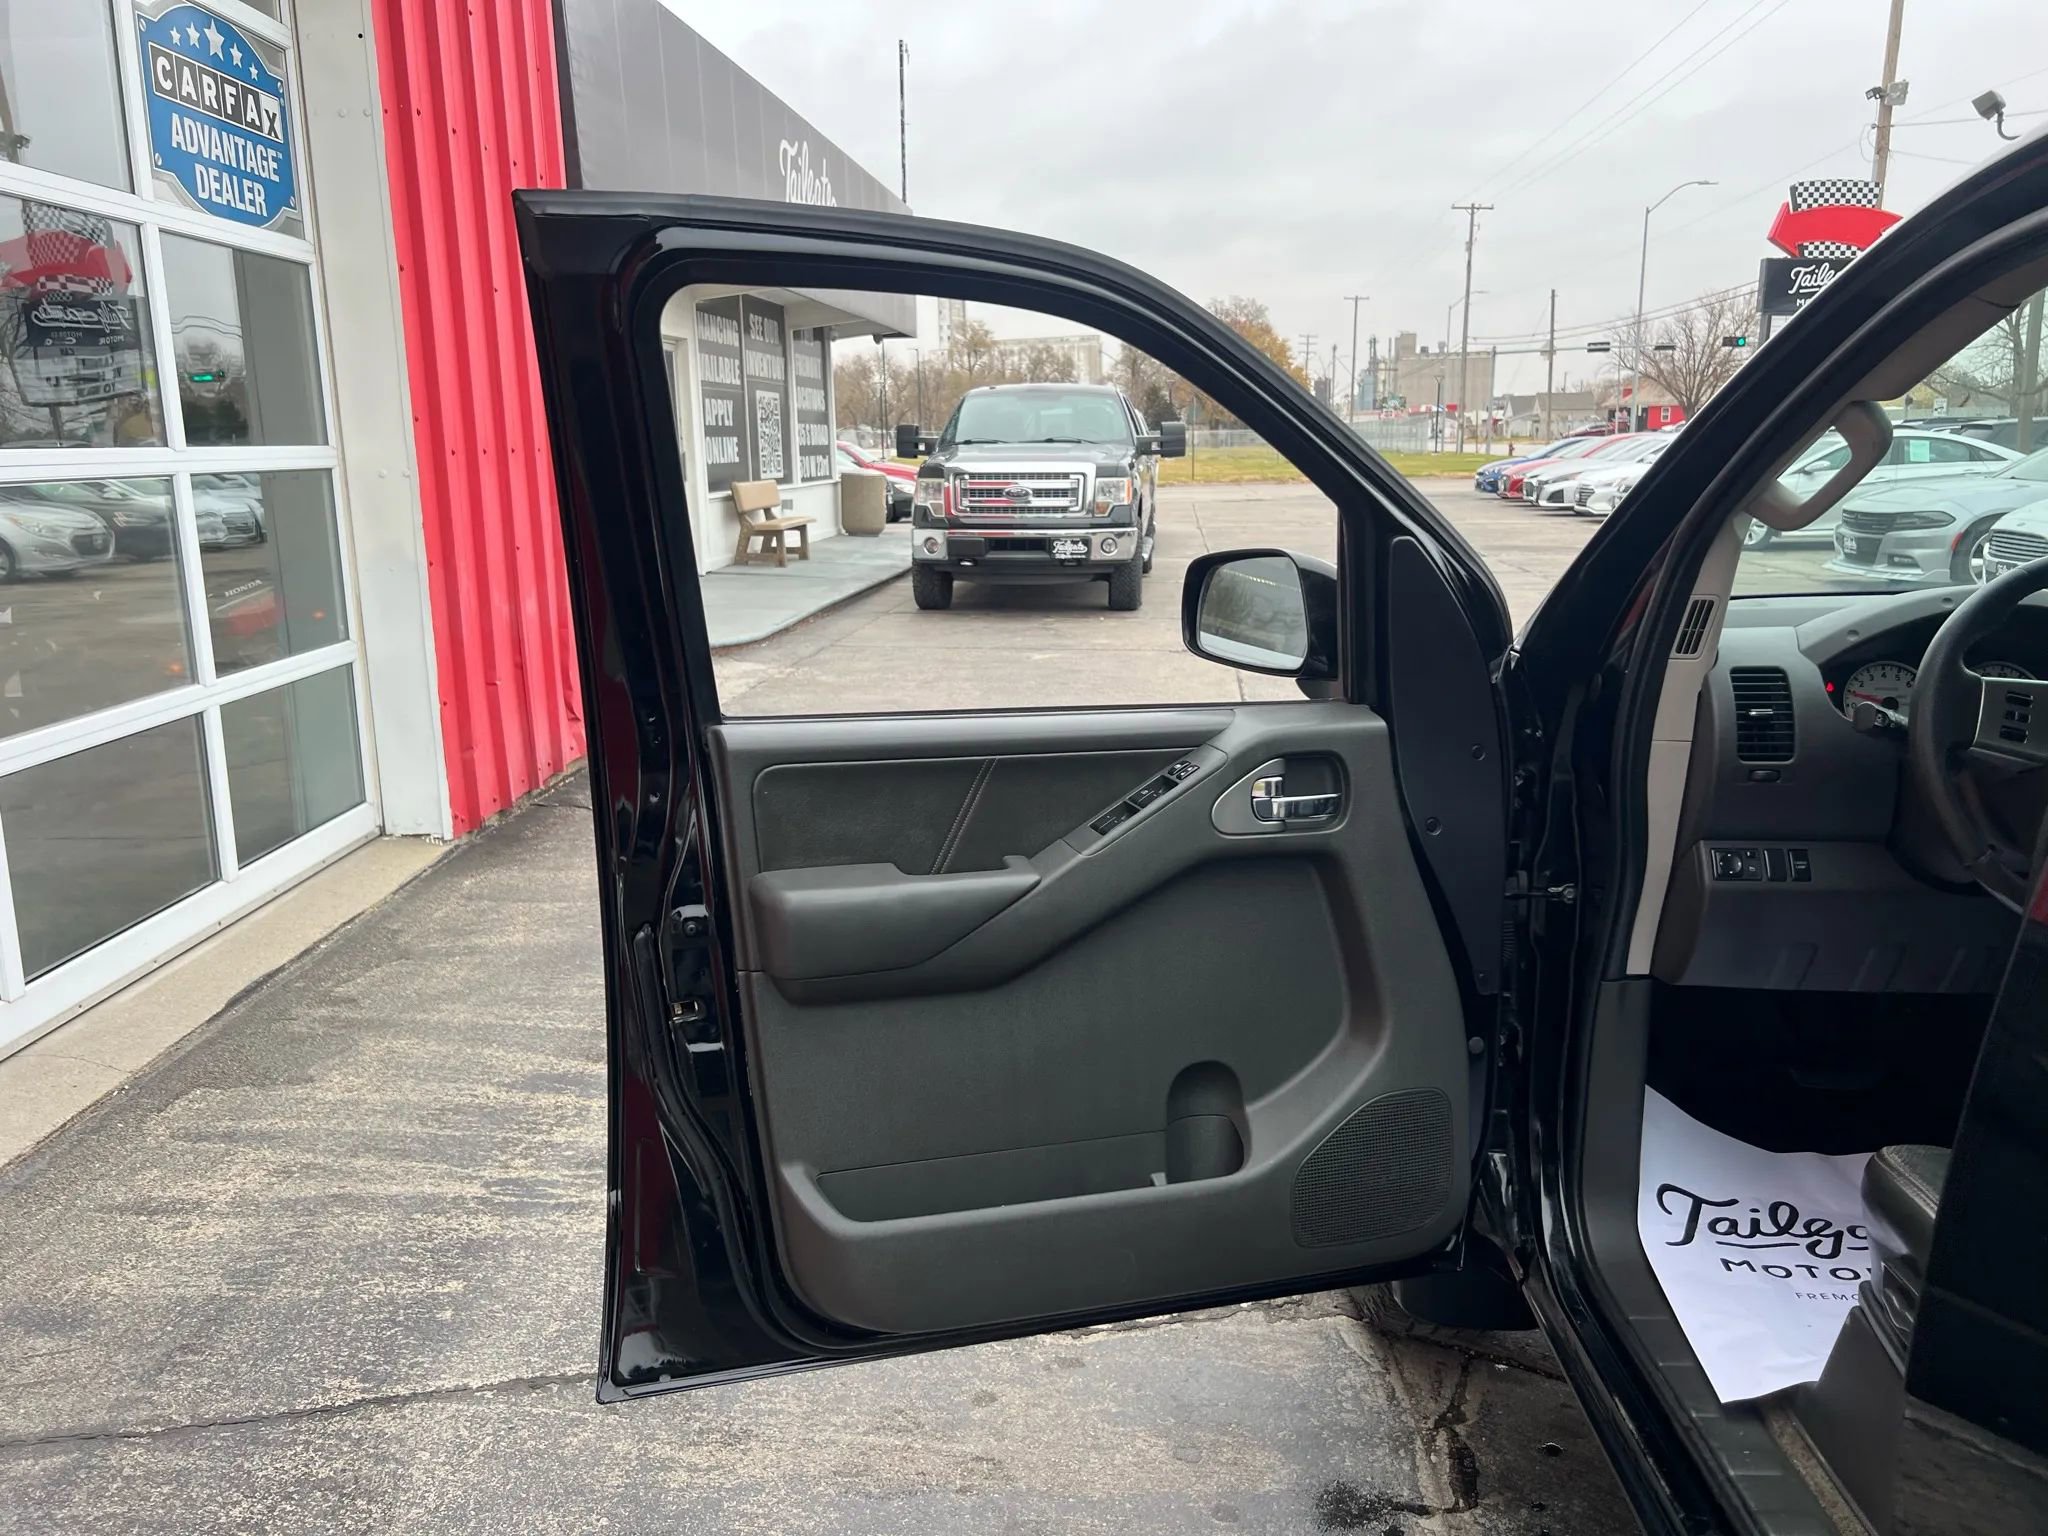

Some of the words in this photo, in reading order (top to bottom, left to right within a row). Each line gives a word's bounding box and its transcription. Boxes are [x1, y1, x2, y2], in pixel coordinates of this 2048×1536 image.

[156, 56, 280, 140] CARFAX
[194, 162, 268, 217] DEALER
[749, 312, 764, 341] SEE
[705, 398, 733, 427] APPLY
[704, 436, 739, 465] ONLINE
[224, 579, 263, 597] HONDA
[1720, 1257, 1872, 1281] MOTO
